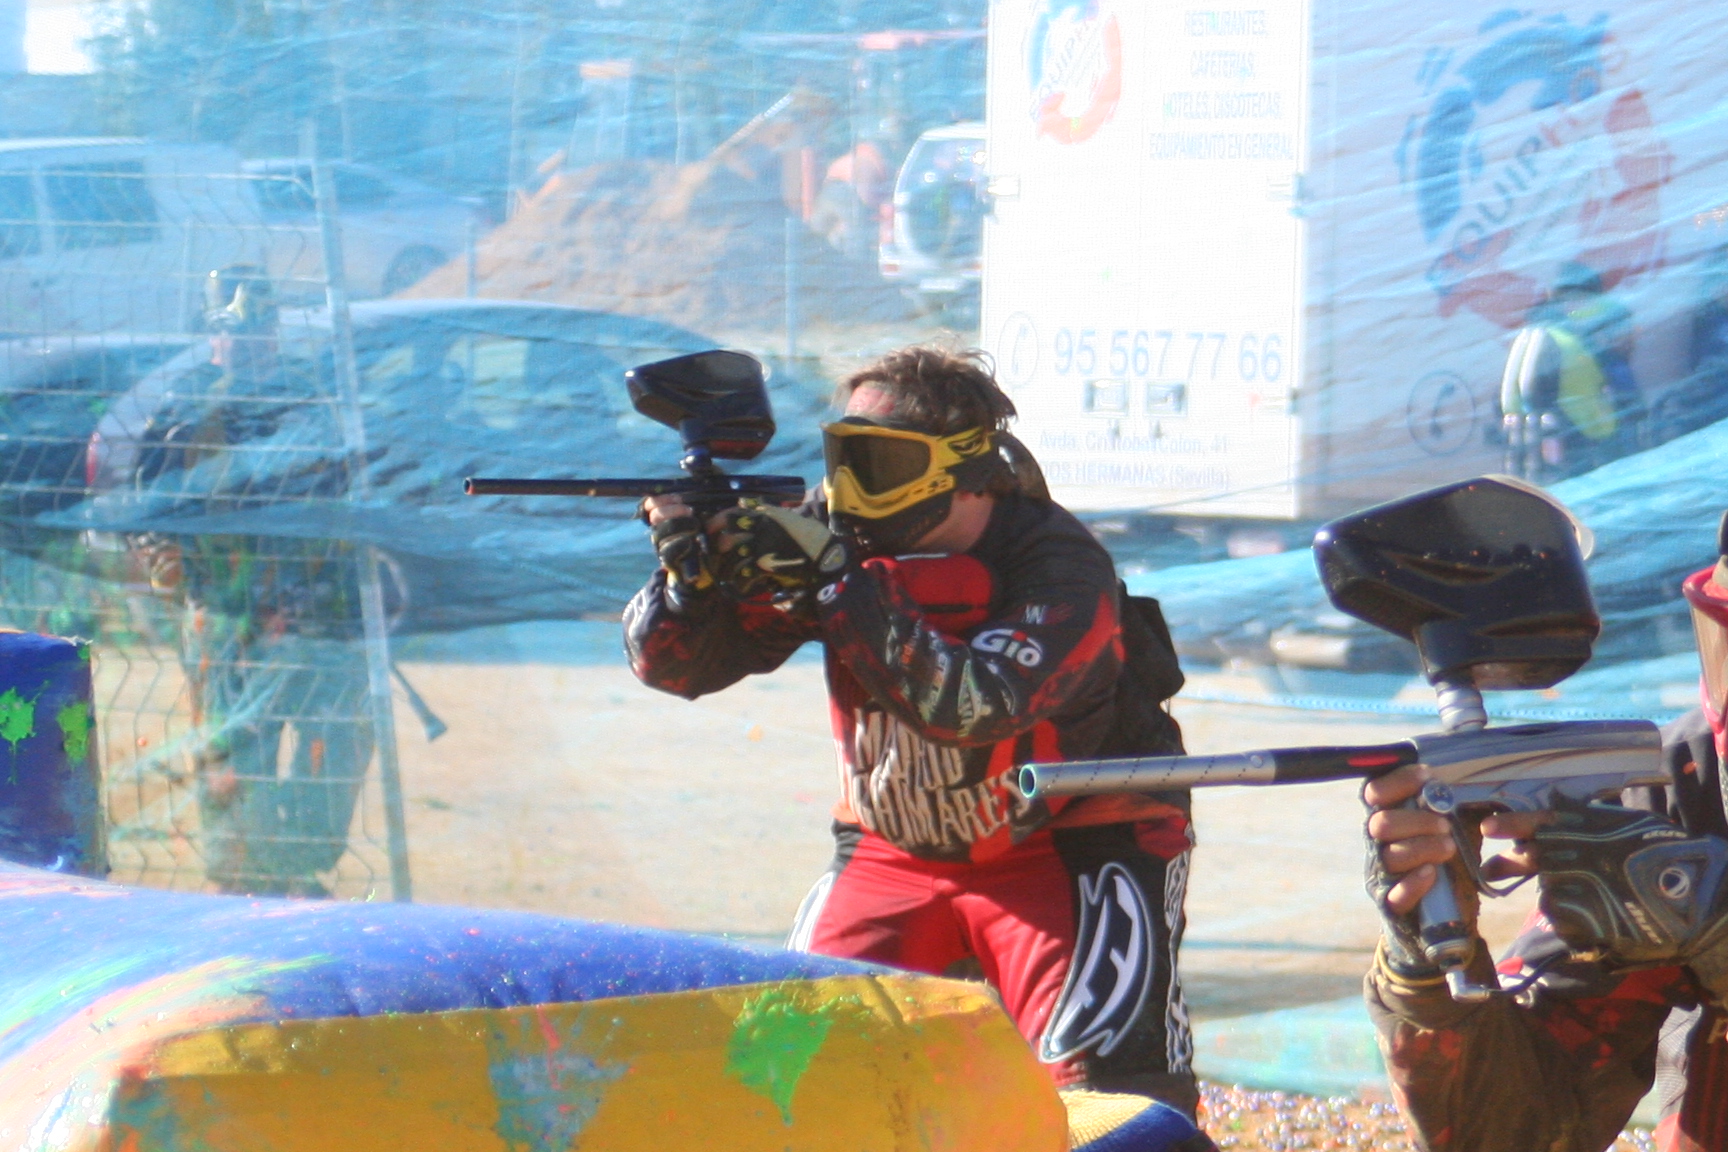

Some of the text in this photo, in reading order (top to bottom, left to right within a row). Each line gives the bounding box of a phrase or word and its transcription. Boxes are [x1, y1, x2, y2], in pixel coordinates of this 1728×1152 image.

[1150, 132, 1294, 161] EQUIPAMIENTO EN GENERAL
[1054, 327, 1283, 383] 95 567 77 66
[1075, 460, 1167, 485] HERMANAS
